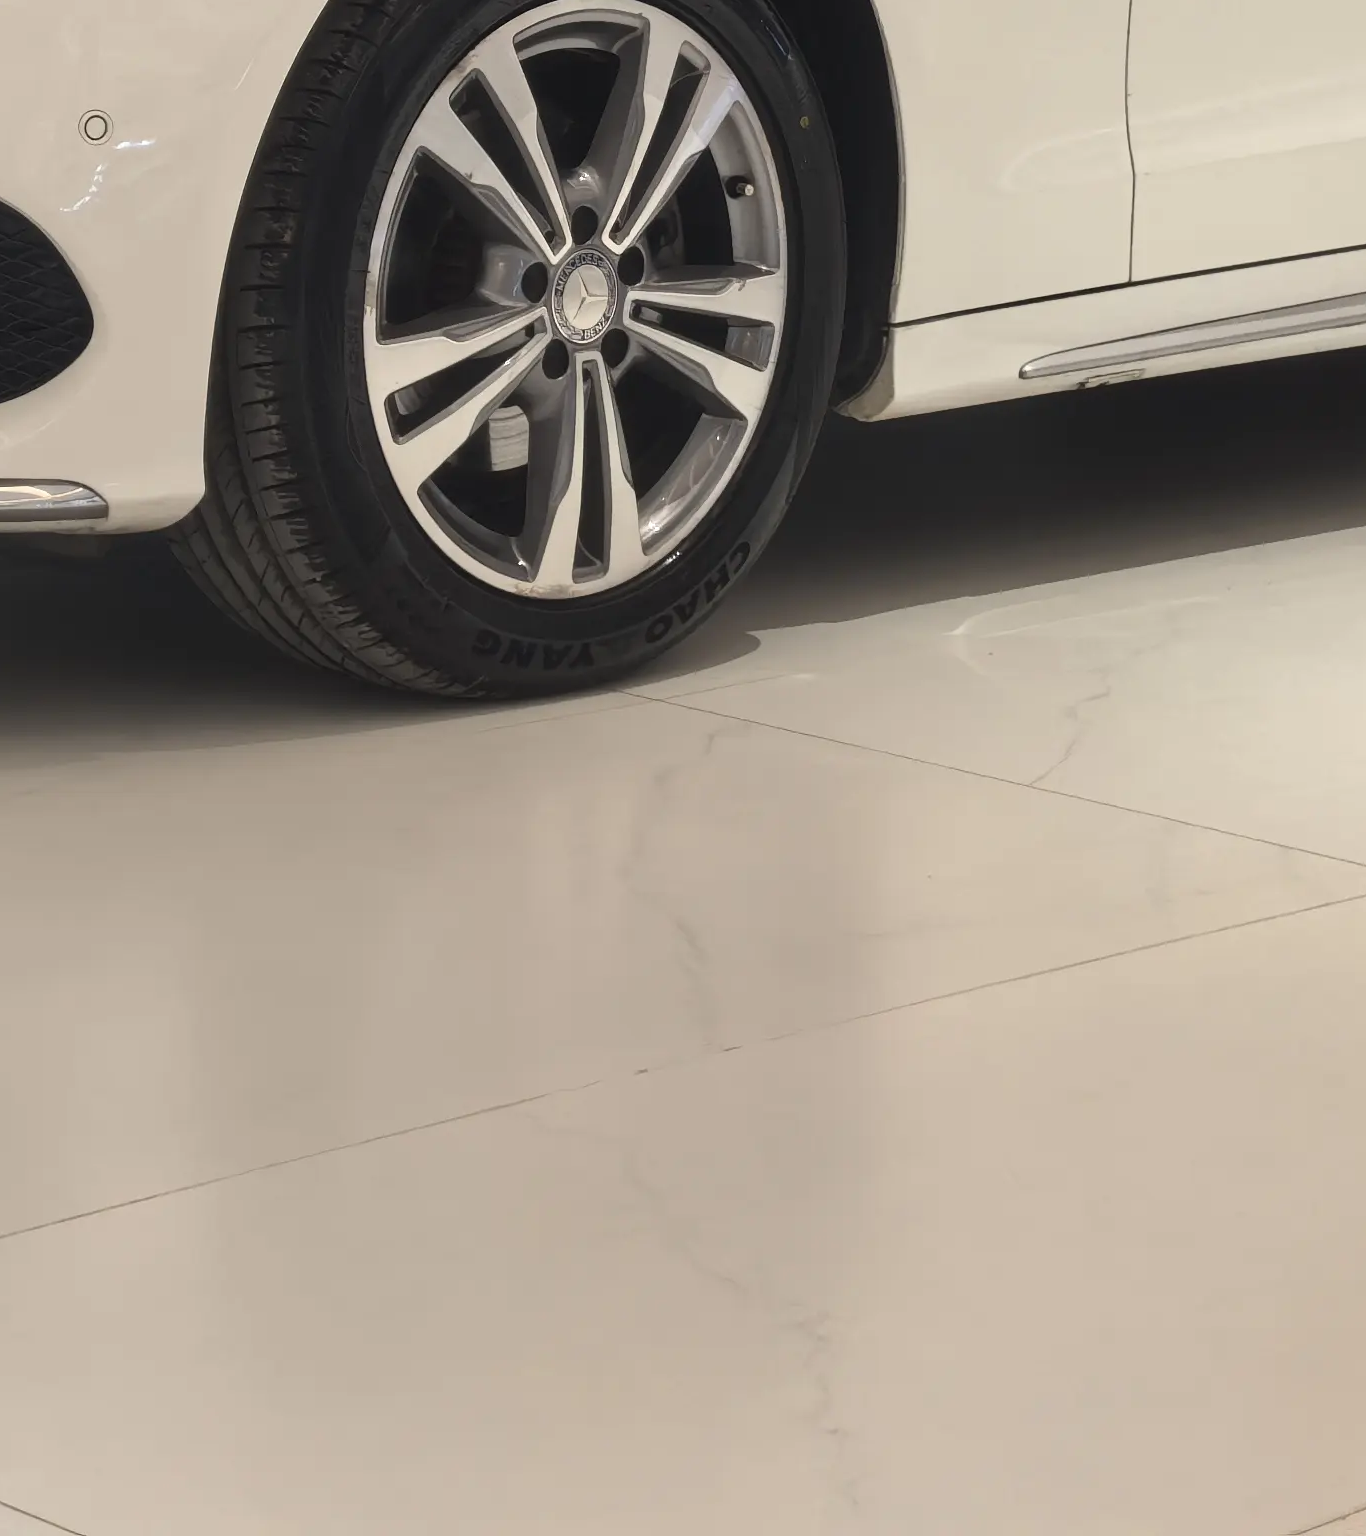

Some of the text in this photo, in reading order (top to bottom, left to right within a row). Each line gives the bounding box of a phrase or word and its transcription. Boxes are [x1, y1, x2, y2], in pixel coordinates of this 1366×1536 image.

[555, 252, 601, 290] MERCEDES
[584, 316, 607, 340] BENZ
[473, 540, 752, 672] CHAO YANG
